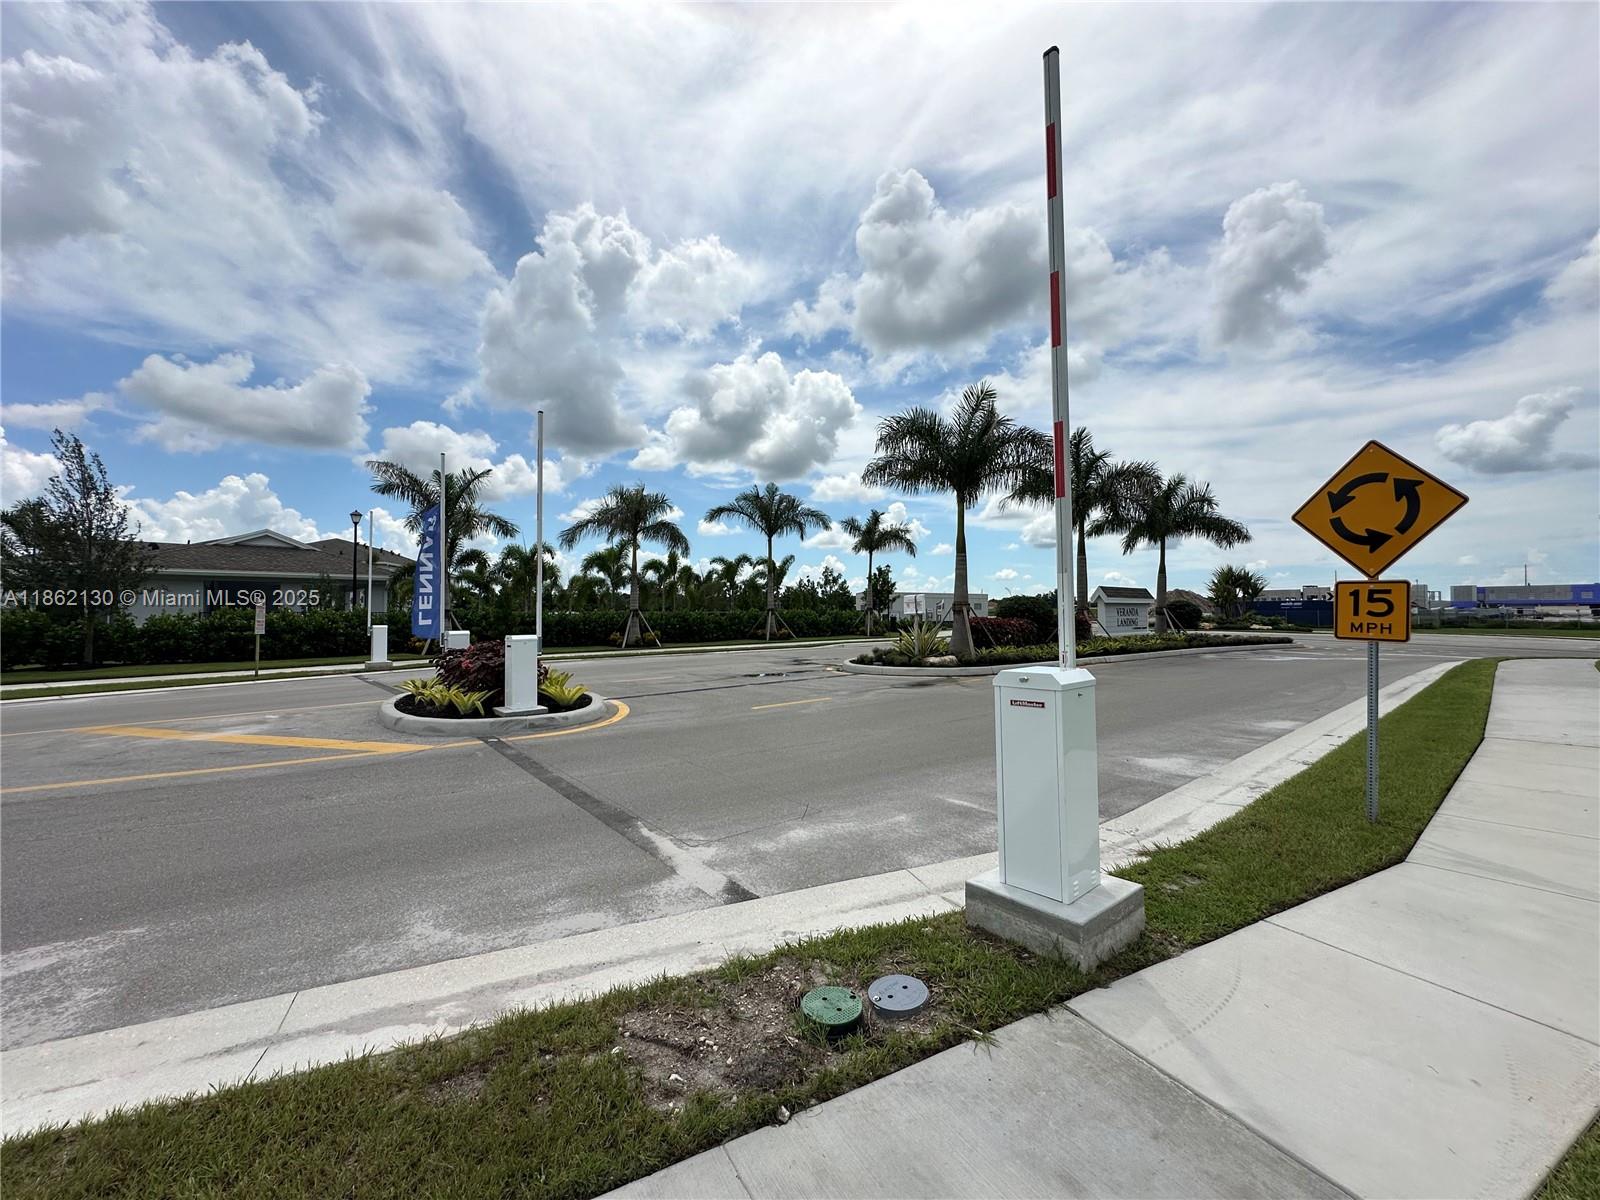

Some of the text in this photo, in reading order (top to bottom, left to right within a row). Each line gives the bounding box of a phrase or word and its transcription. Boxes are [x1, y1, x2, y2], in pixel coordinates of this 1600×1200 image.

[1349, 589, 1394, 618] 15
[1116, 607, 1139, 617] VERANDA
[1116, 617, 1139, 627] LANDING
[1350, 622, 1392, 635] MPH
